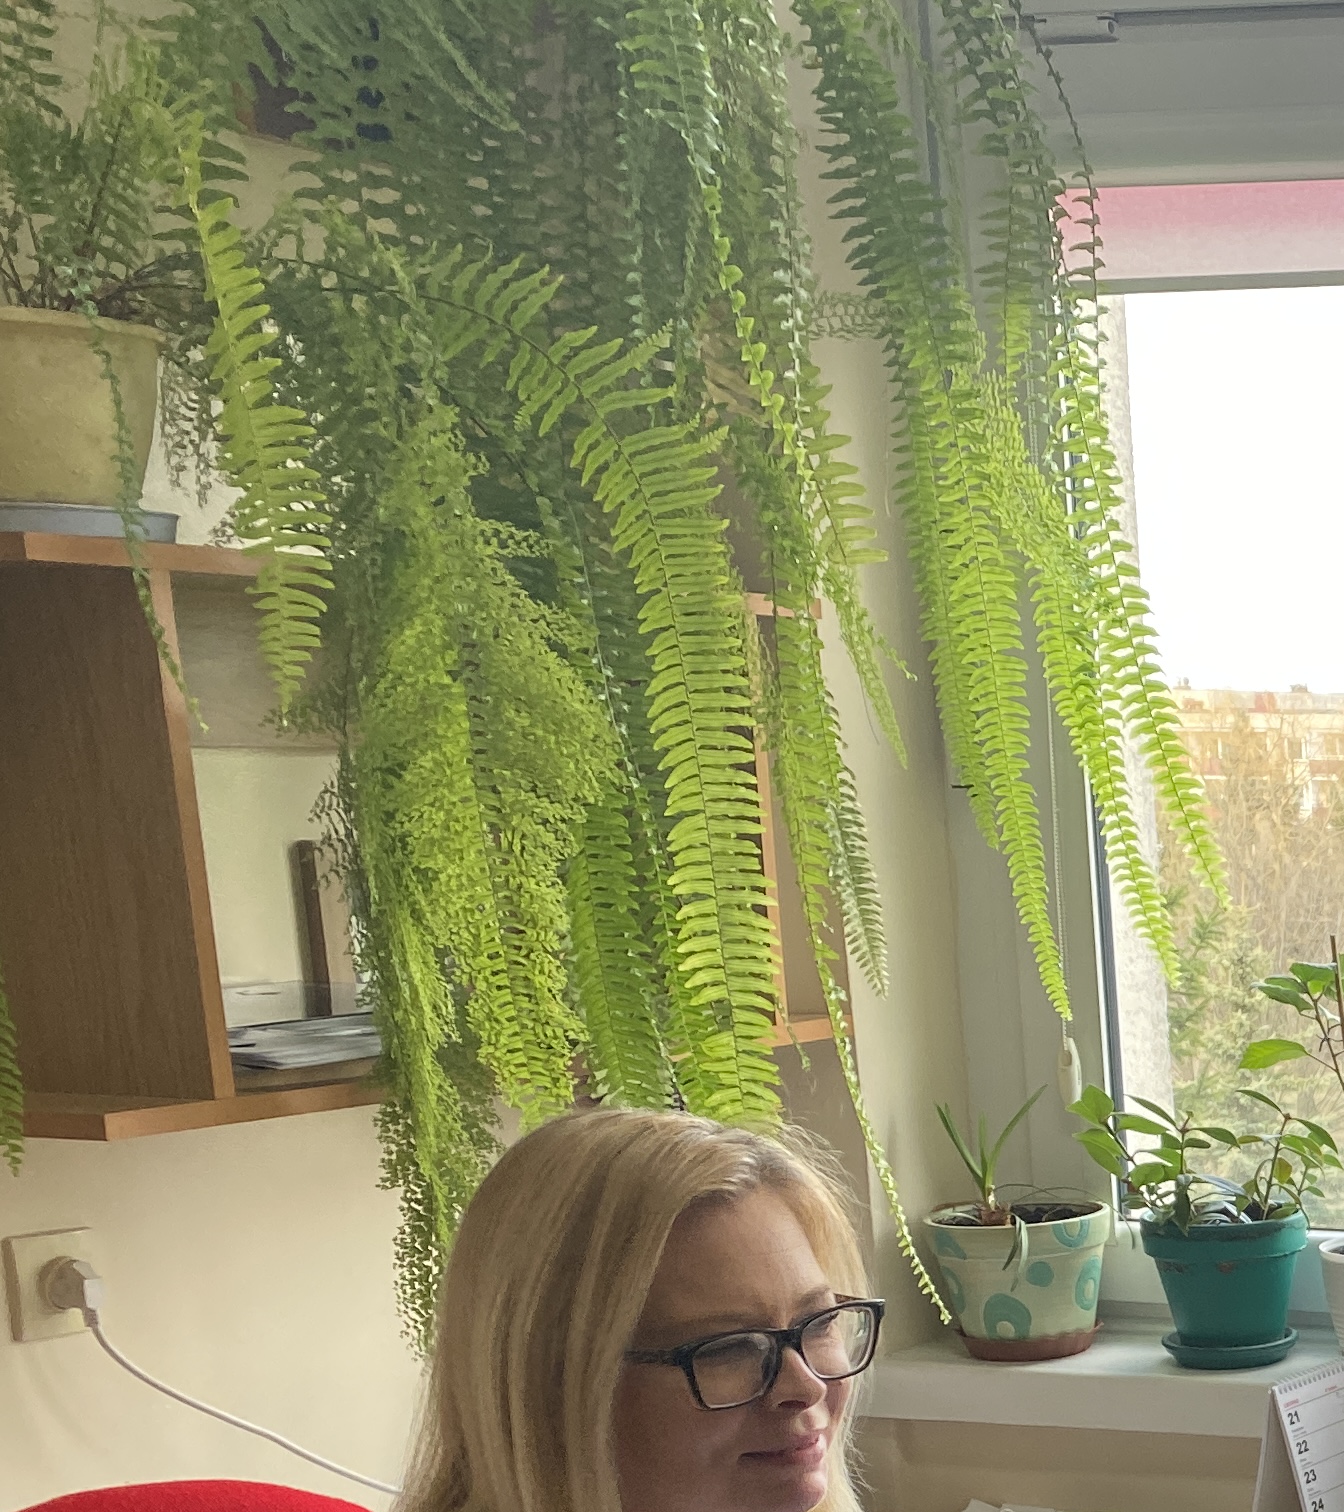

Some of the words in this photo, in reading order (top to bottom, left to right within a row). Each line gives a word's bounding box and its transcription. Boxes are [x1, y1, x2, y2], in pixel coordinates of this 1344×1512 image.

[1287, 1410, 1300, 1425] 21
[1296, 1440, 1309, 1455] 22
[1303, 1469, 1317, 1484] 23
[1311, 1498, 1324, 1512] 24
